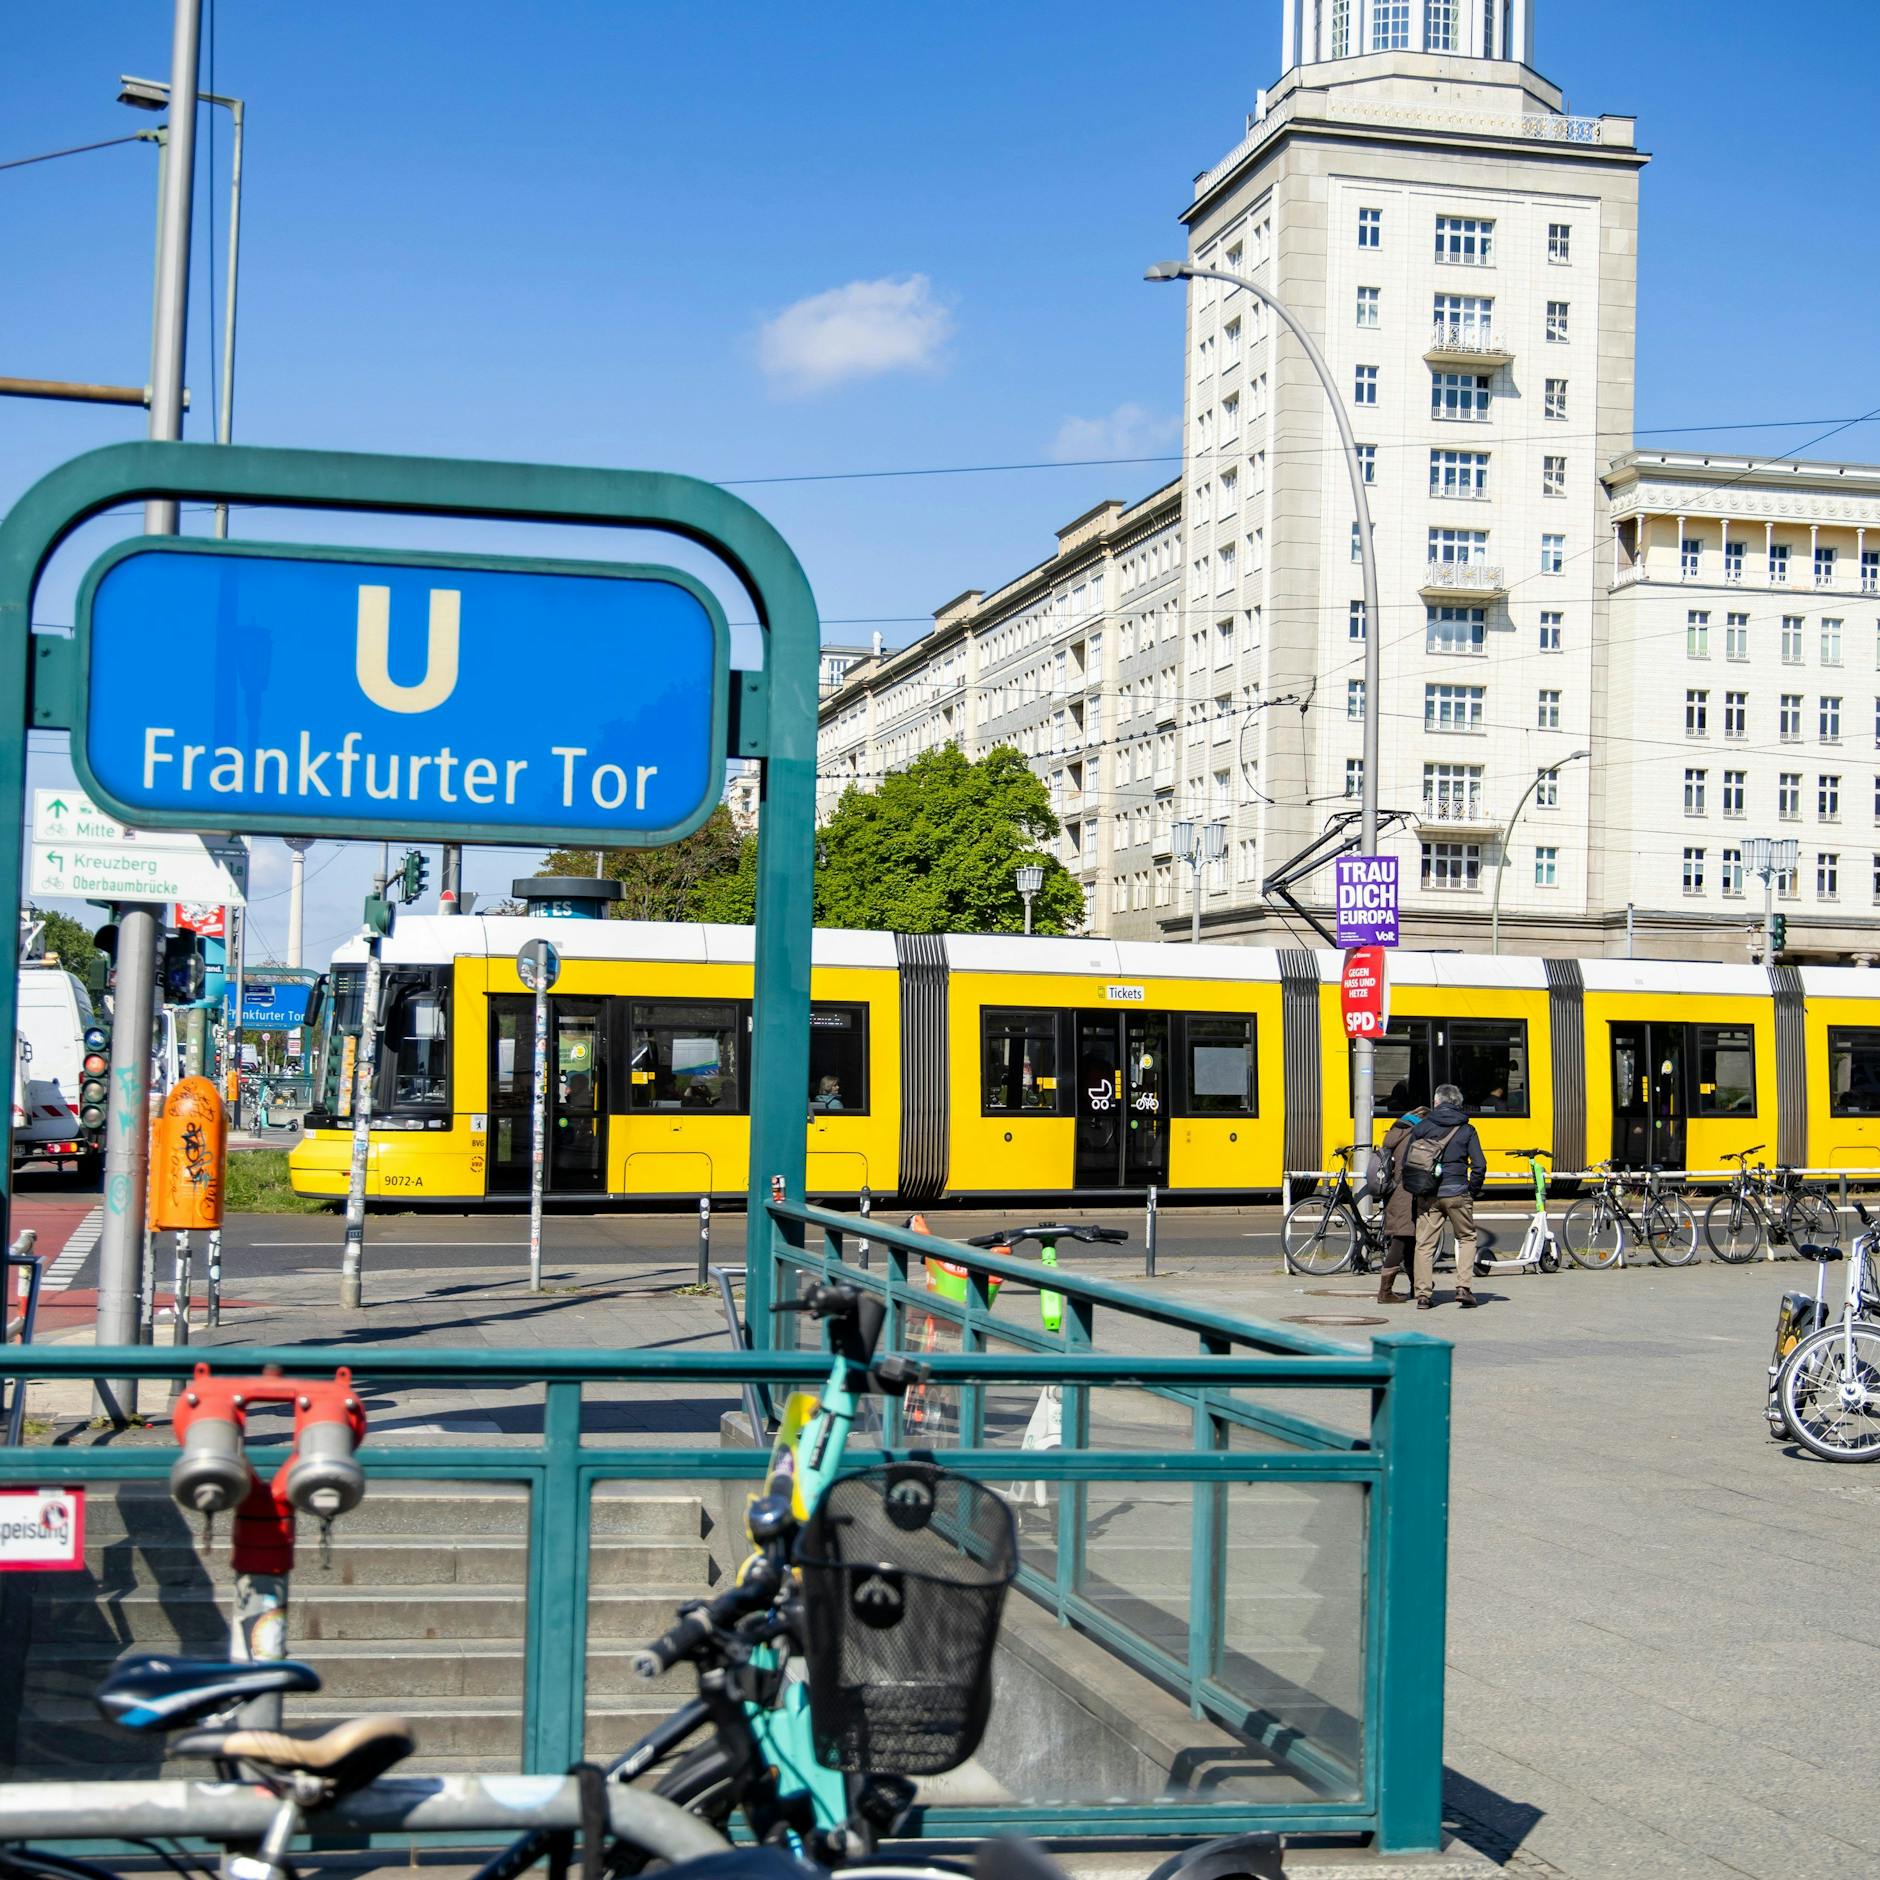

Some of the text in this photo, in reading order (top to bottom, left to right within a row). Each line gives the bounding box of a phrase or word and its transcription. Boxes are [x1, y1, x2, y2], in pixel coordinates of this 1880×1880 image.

[355, 584, 461, 714] U
[142, 726, 658, 811] Frankfurter Tor
[76, 822, 115, 839] Mitte
[74, 853, 158, 874] Kreuzberg
[1339, 861, 1396, 883] TRAU
[72, 875, 178, 895] Oberbaumbrücke
[1339, 884, 1396, 909] DICH
[552, 900, 573, 917] ES
[1340, 909, 1396, 925] EUROPA
[1375, 931, 1396, 942] Volt
[1348, 968, 1370, 978] GEGEN
[1344, 978, 1376, 989] HASS UND
[1109, 987, 1142, 1000] Tickets
[1348, 988, 1368, 998] HETZE
[228, 1009, 305, 1020] rnkfurter Tor
[1346, 1011, 1375, 1032] SPD
[472, 1139, 485, 1147] BVG
[384, 1175, 424, 1187] 9072-A
[0, 1515, 68, 1546] peisung
